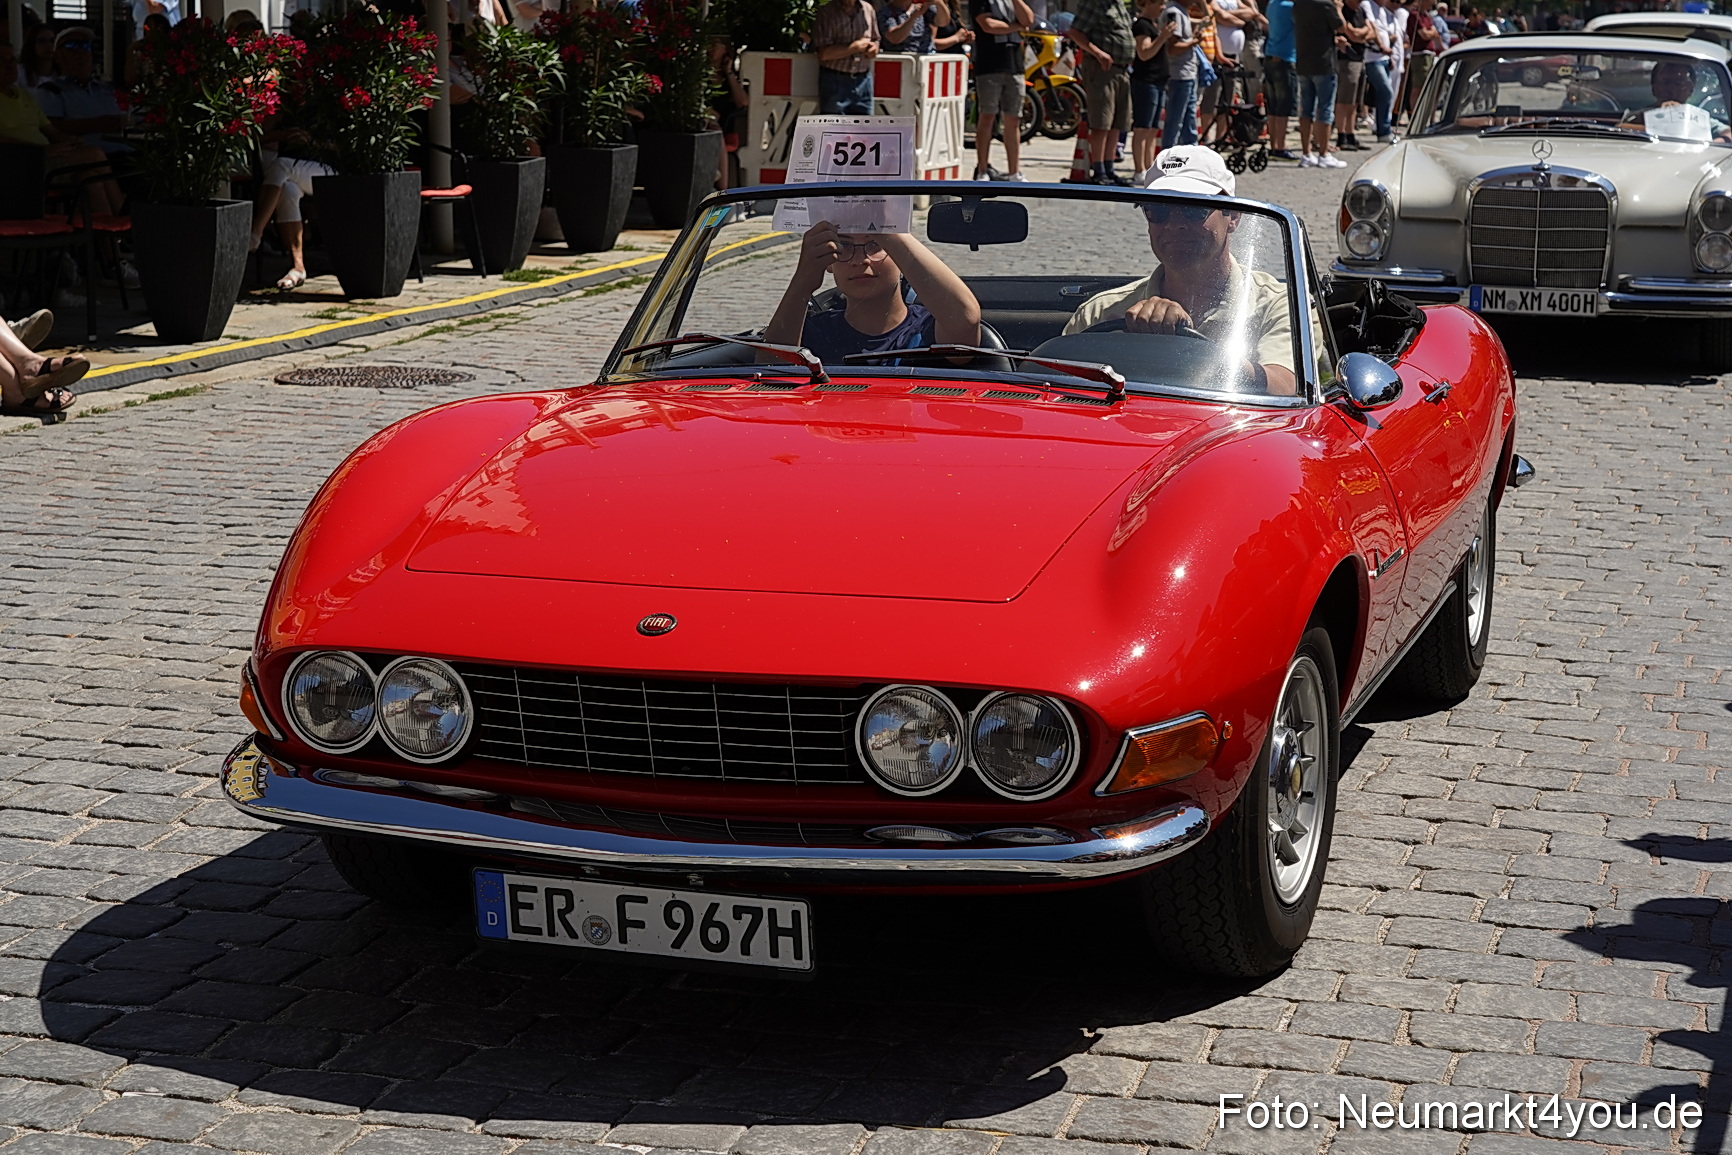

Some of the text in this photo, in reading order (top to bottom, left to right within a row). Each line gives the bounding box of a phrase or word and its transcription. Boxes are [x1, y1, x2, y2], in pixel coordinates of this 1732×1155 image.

[833, 141, 880, 166] 521
[1482, 289, 1595, 313] NM XM 400H
[644, 617, 670, 627] FIAT
[487, 911, 498, 926] D
[508, 884, 804, 961] ER F 967H
